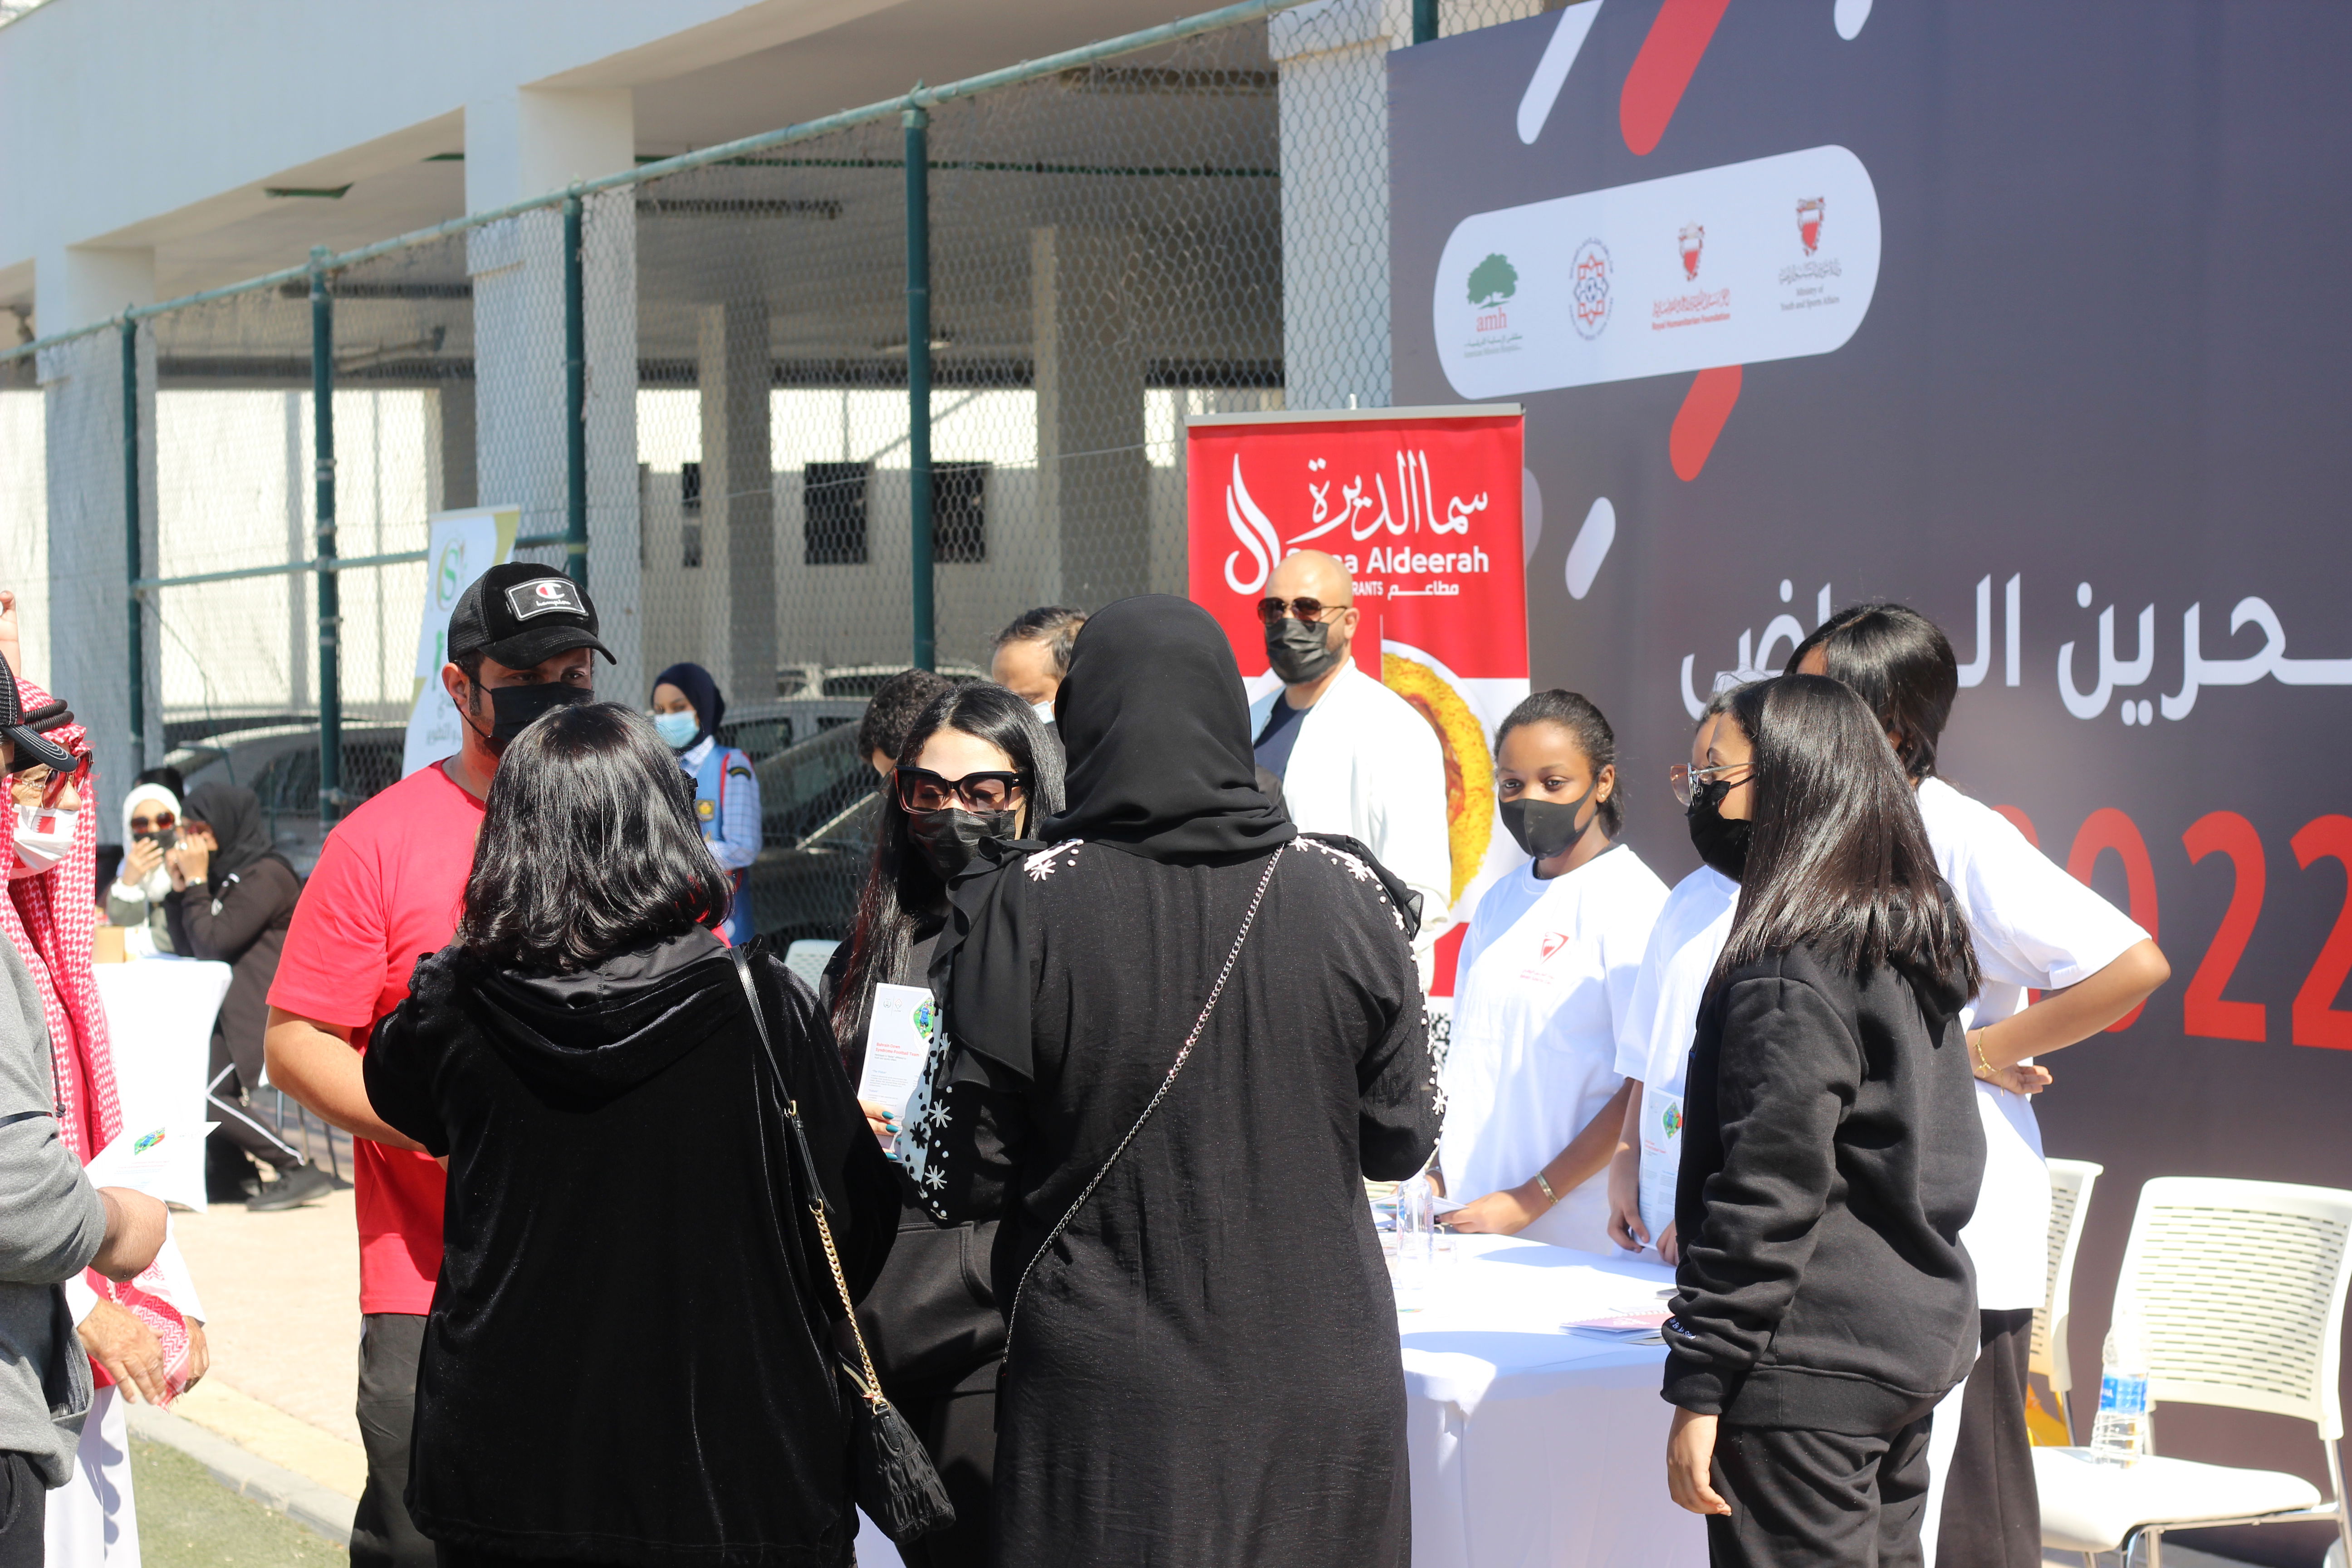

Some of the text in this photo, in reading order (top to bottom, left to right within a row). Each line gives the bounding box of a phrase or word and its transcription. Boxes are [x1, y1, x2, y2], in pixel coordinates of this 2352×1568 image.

[1476, 305, 1507, 333] amh
[1366, 546, 1489, 574] Aldeerah
[1991, 804, 2352, 1051] 022
